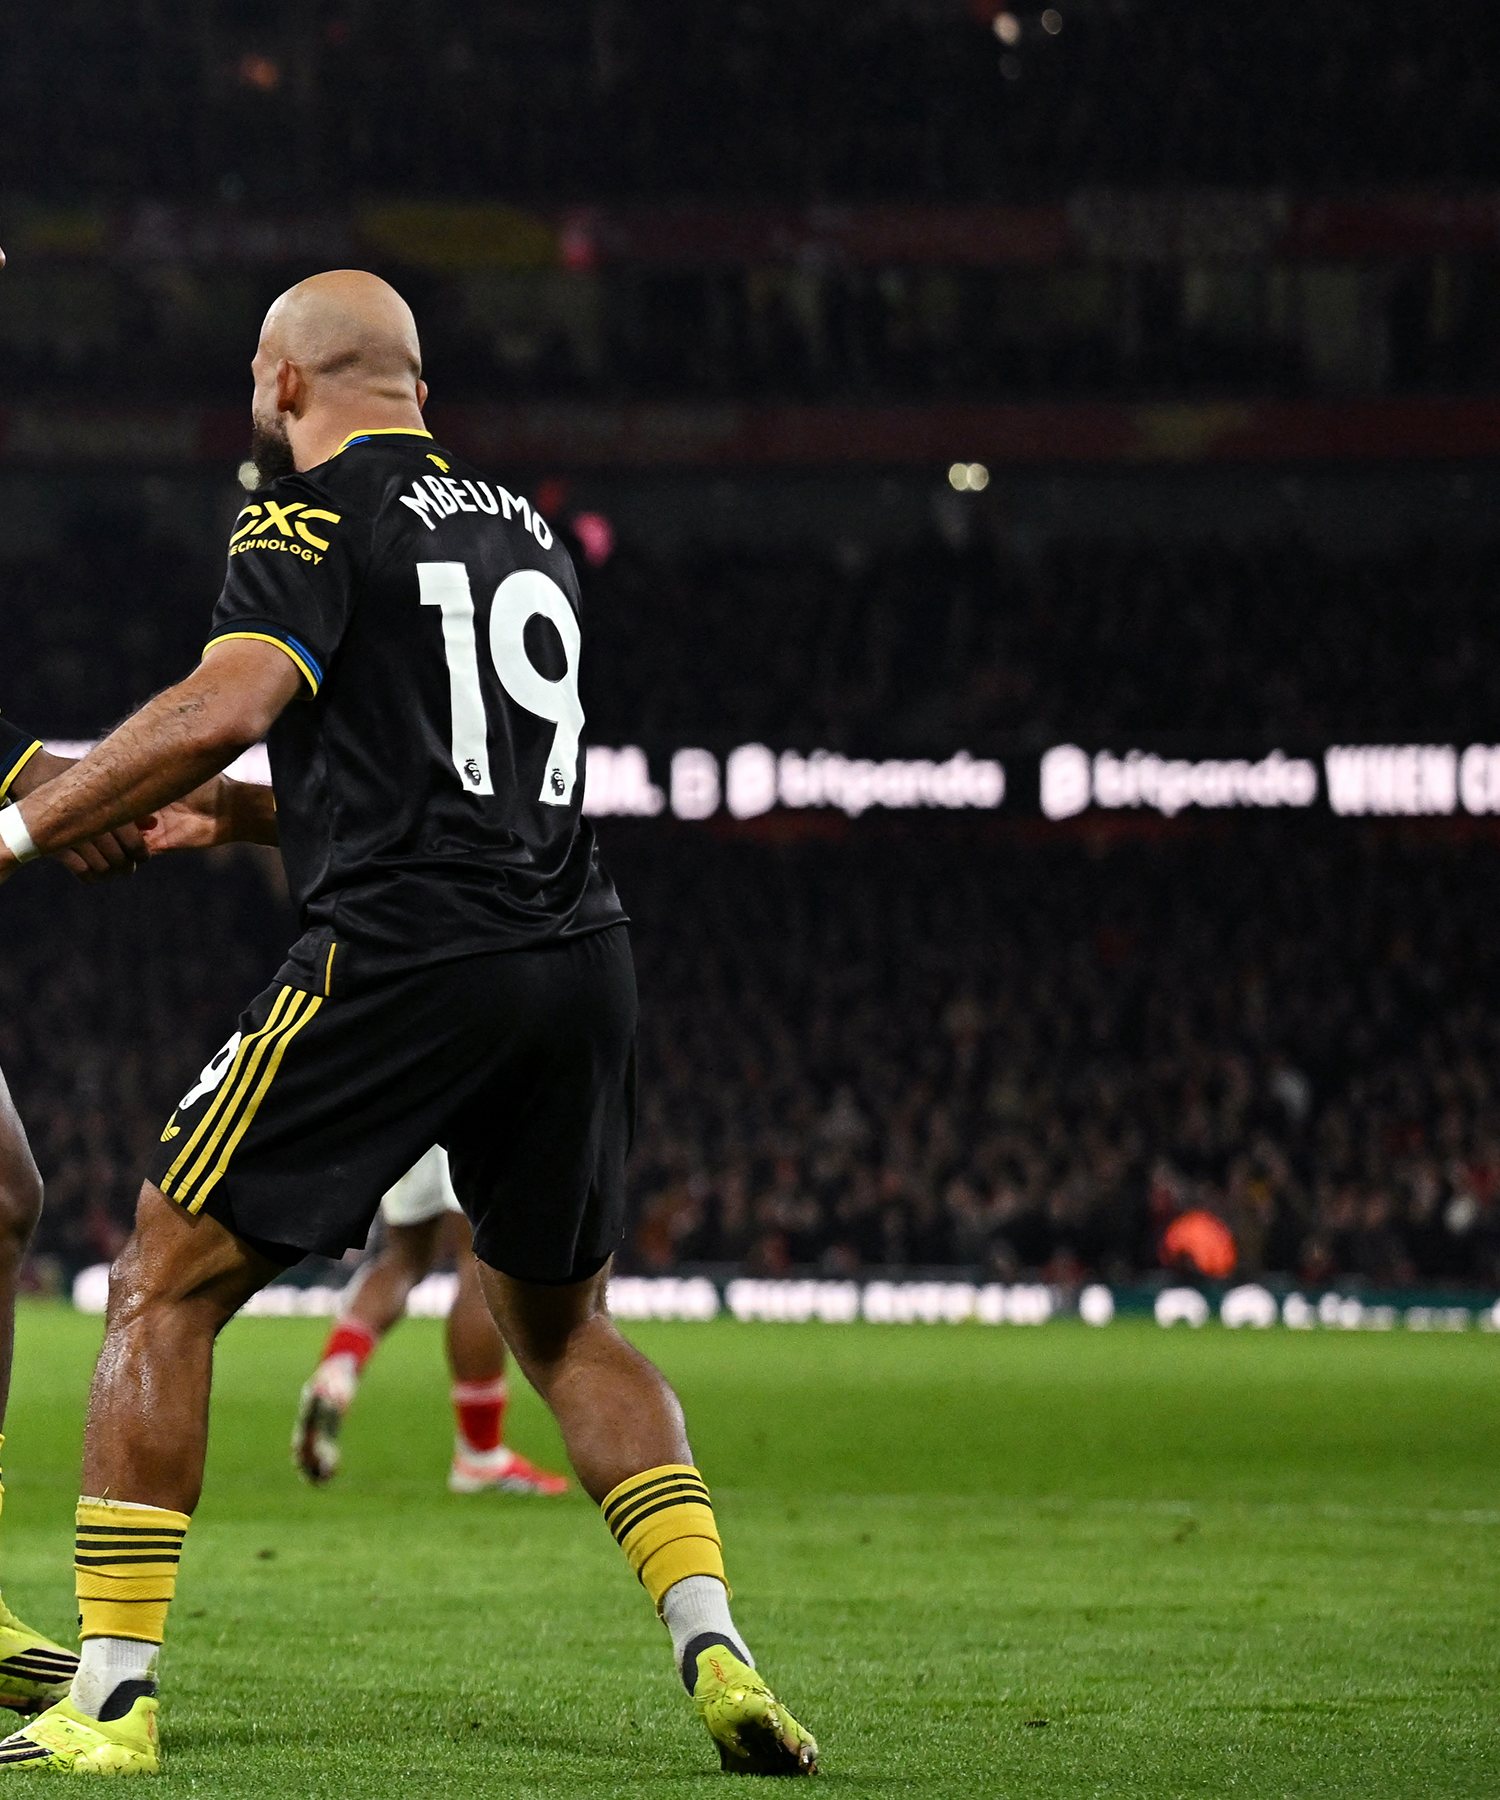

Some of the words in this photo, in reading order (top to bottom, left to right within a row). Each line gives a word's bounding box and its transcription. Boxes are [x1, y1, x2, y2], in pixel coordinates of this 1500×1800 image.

[399, 475, 553, 550] MBEUMO
[228, 539, 323, 566] ECHNOLOGY
[417, 561, 585, 806] 19
